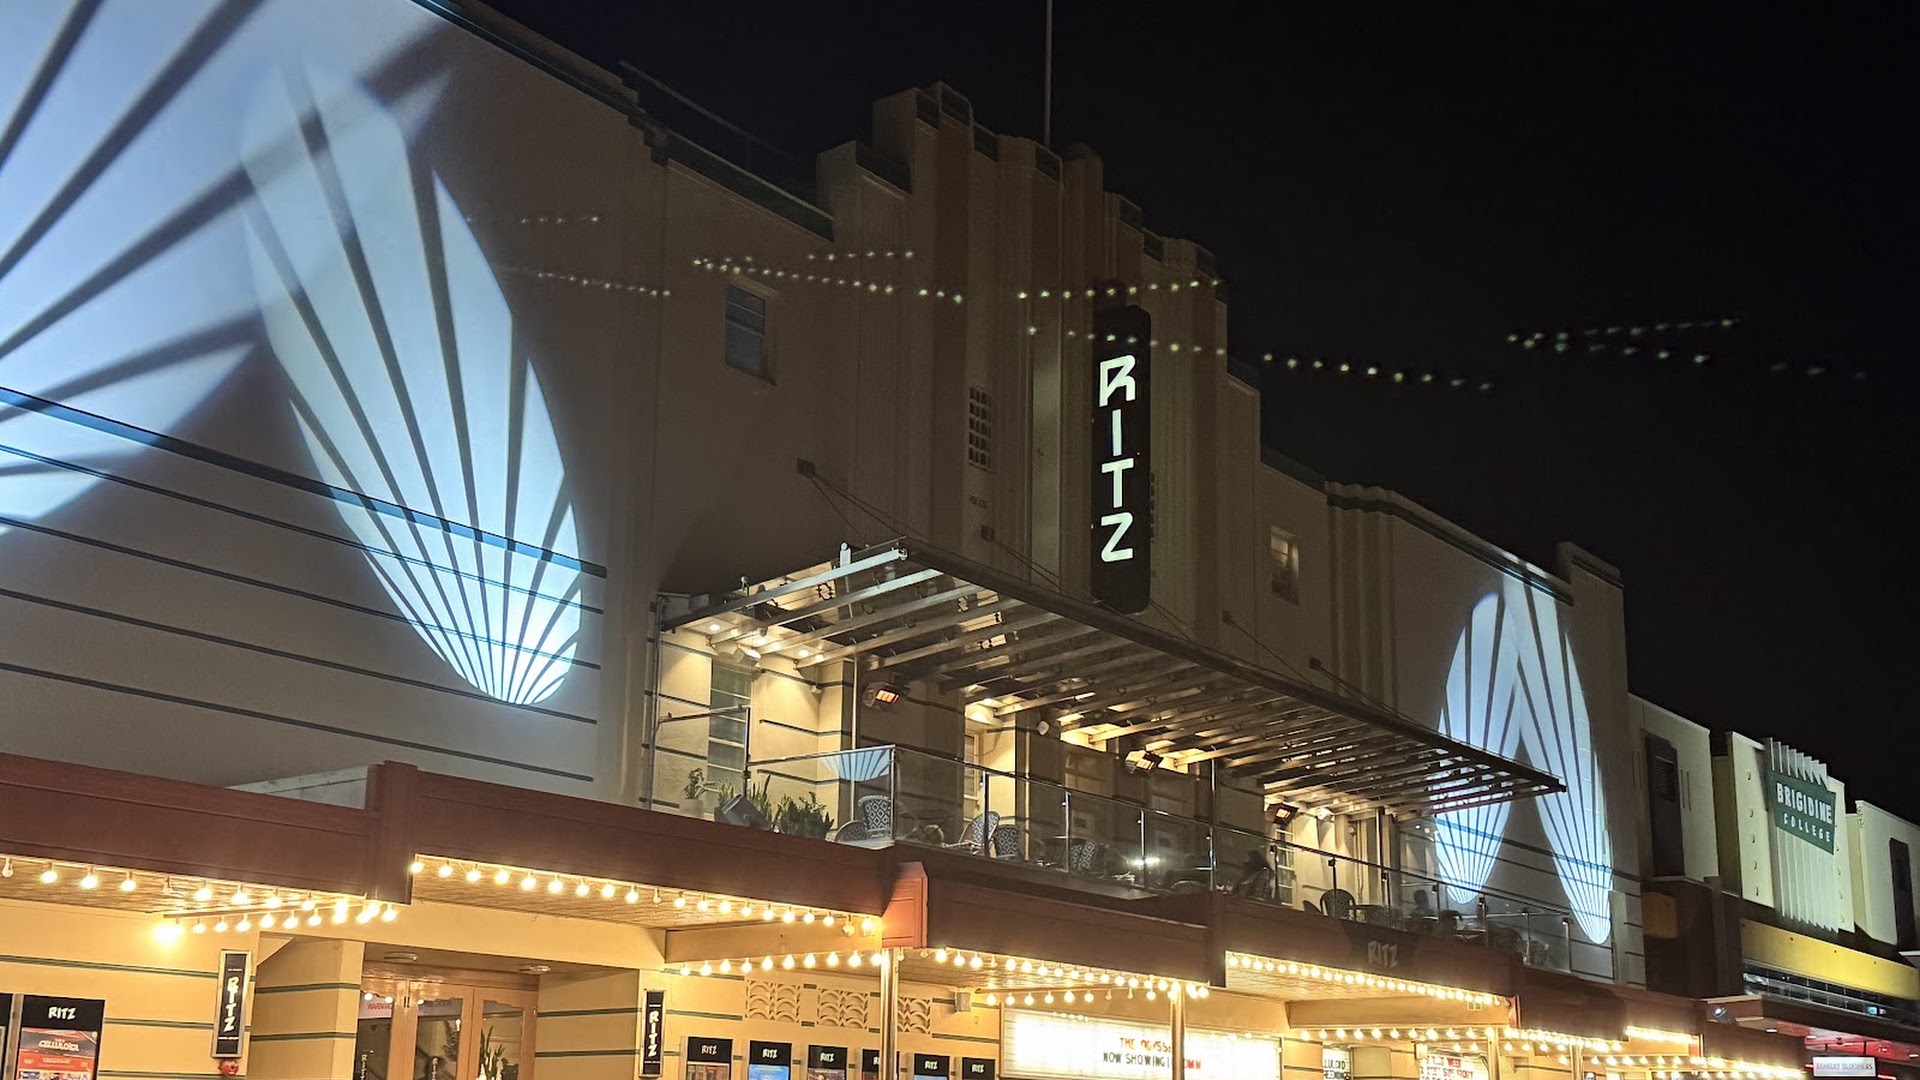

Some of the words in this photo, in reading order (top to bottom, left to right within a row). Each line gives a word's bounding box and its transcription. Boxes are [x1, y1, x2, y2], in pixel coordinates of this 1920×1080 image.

[1100, 355, 1136, 562] RITZ
[1776, 782, 1833, 825] BRIGIDINE
[1784, 812, 1831, 842] COLLEGE
[1367, 940, 1399, 968] RITZ
[223, 976, 239, 1032] RITZ
[48, 1006, 77, 1020] RITZ
[648, 1010, 660, 1057] RITZ
[701, 1045, 718, 1056] RITZ
[1119, 1037, 1136, 1050] THE
[762, 1048, 778, 1059] RITZ
[820, 1052, 835, 1063] RITZ
[1103, 1052, 1122, 1064] NOW
[1126, 1053, 1165, 1068] SHOWING
[924, 1060, 938, 1070] RITZ
[971, 1064, 985, 1074] RITZ
